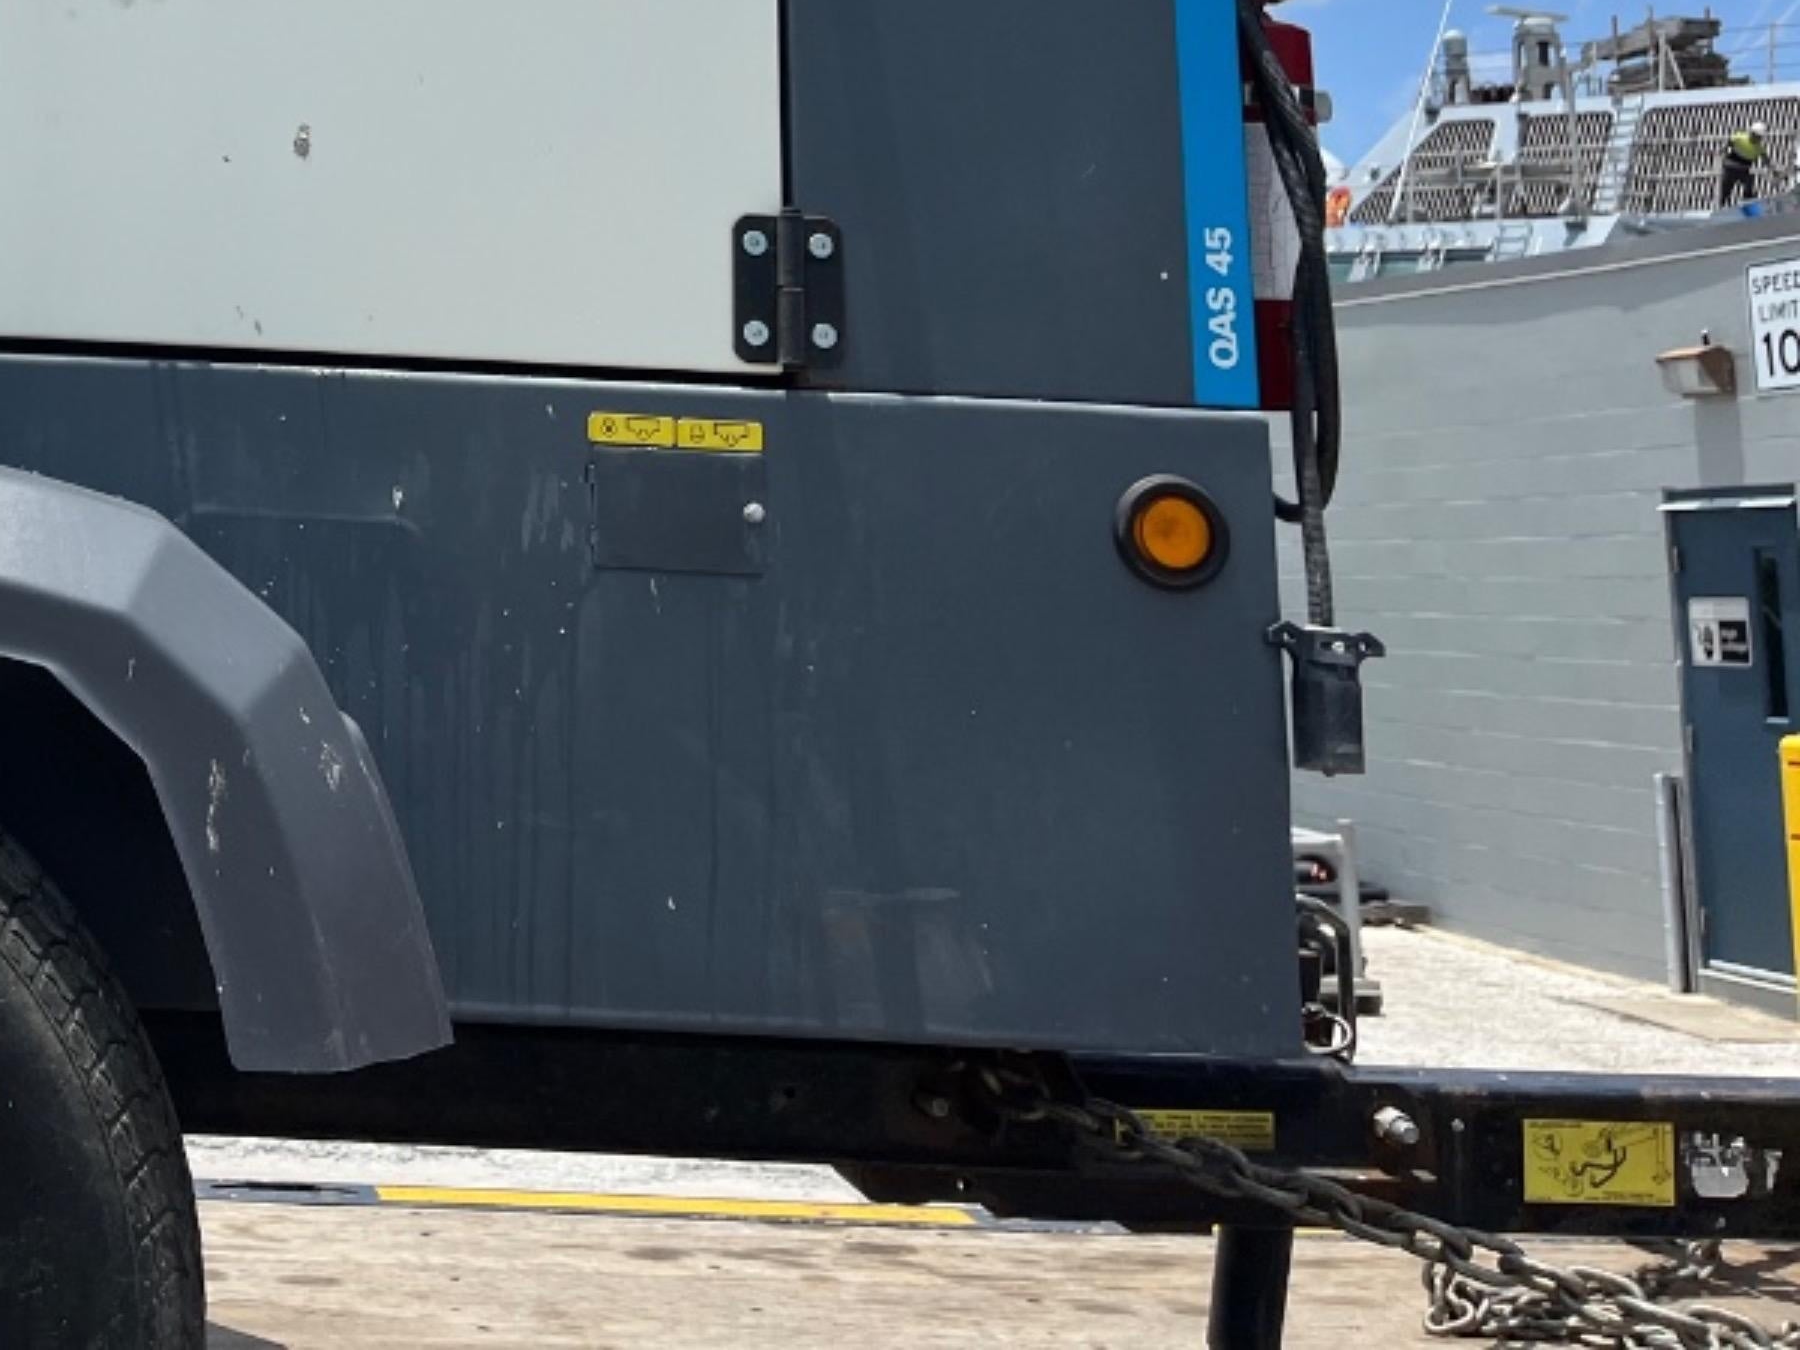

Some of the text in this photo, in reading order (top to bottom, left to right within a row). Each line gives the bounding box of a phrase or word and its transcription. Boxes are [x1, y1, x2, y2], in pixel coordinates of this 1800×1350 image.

[1204, 226, 1240, 370] QAS 45
[1763, 329, 1800, 378] 10
